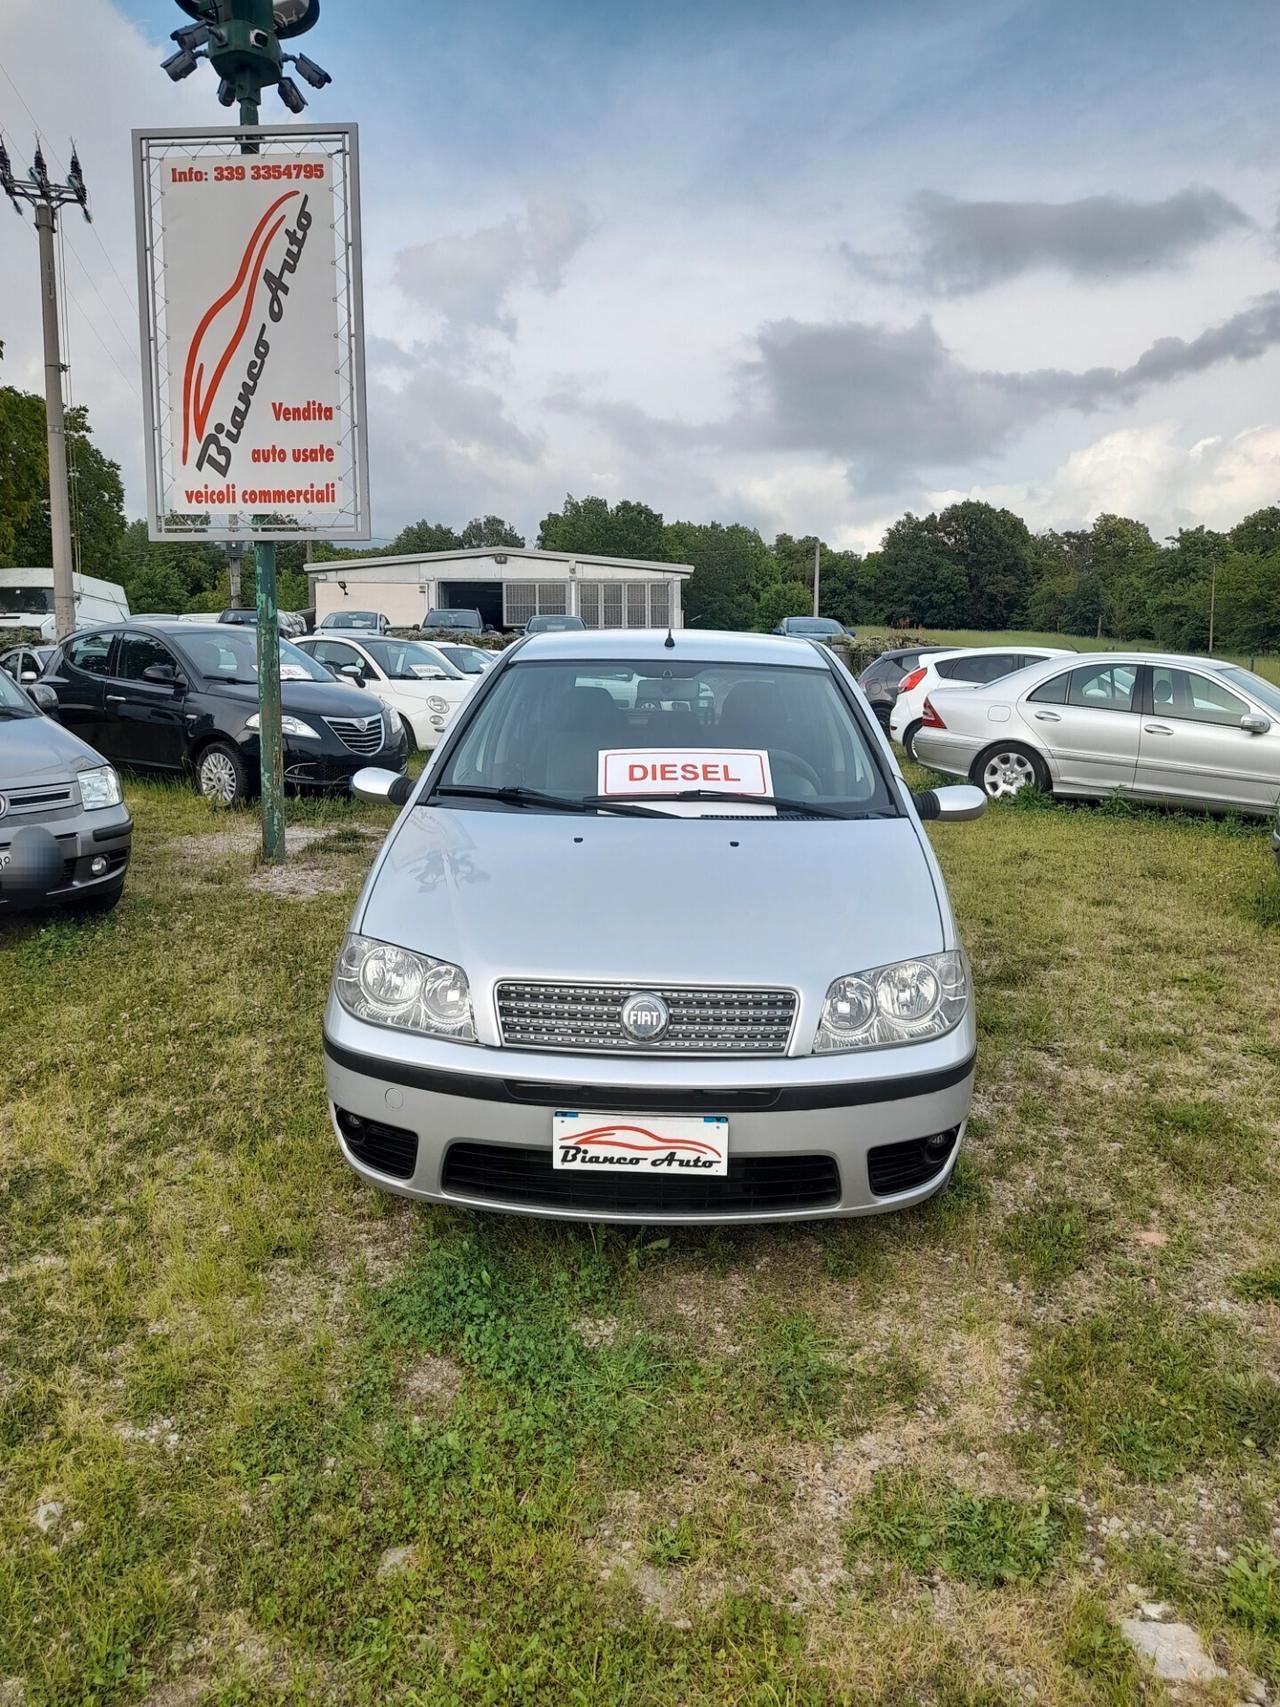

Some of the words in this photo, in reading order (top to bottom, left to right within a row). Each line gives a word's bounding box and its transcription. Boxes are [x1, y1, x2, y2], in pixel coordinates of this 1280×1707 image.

[171, 167, 209, 183] Info:
[213, 165, 246, 182] 339
[250, 163, 325, 181] 3354795
[195, 323, 270, 478] Bianco
[262, 193, 313, 323] Auto
[271, 400, 334, 422] Vendita
[251, 445, 287, 464] auto
[291, 444, 335, 463] usate
[184, 483, 237, 504] veicoli
[241, 482, 336, 504] commerciali
[628, 763, 741, 783] DIESEL
[629, 1010, 659, 1026] FIAT
[559, 1145, 649, 1166] Bianco
[650, 1151, 722, 1169] Auto
